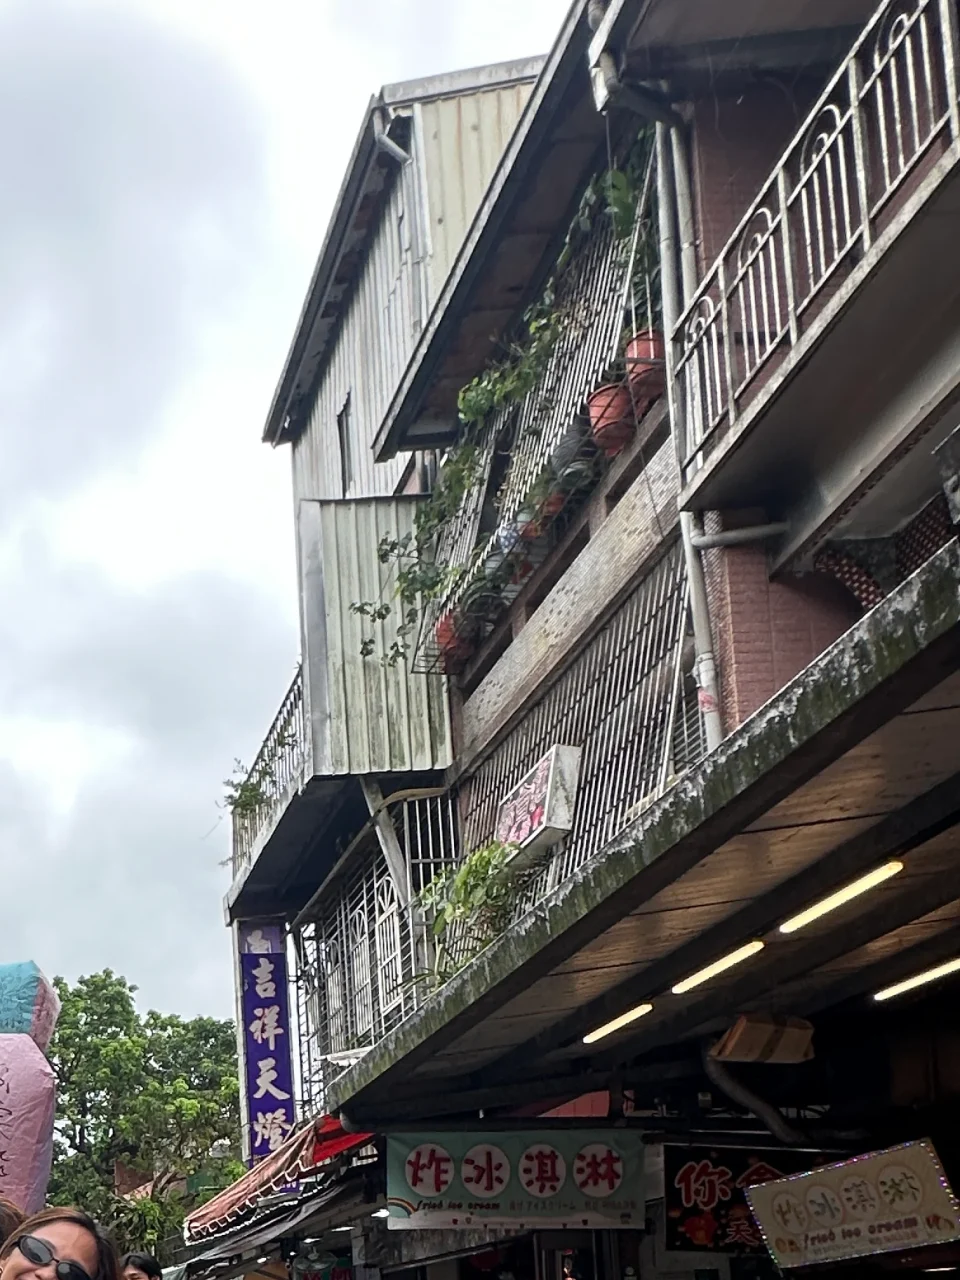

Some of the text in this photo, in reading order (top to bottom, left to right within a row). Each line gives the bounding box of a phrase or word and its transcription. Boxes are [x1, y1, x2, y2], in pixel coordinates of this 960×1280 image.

[249, 957, 290, 1151] 吉祥天燈
[407, 1148, 621, 1193] 炸冰淇淋
